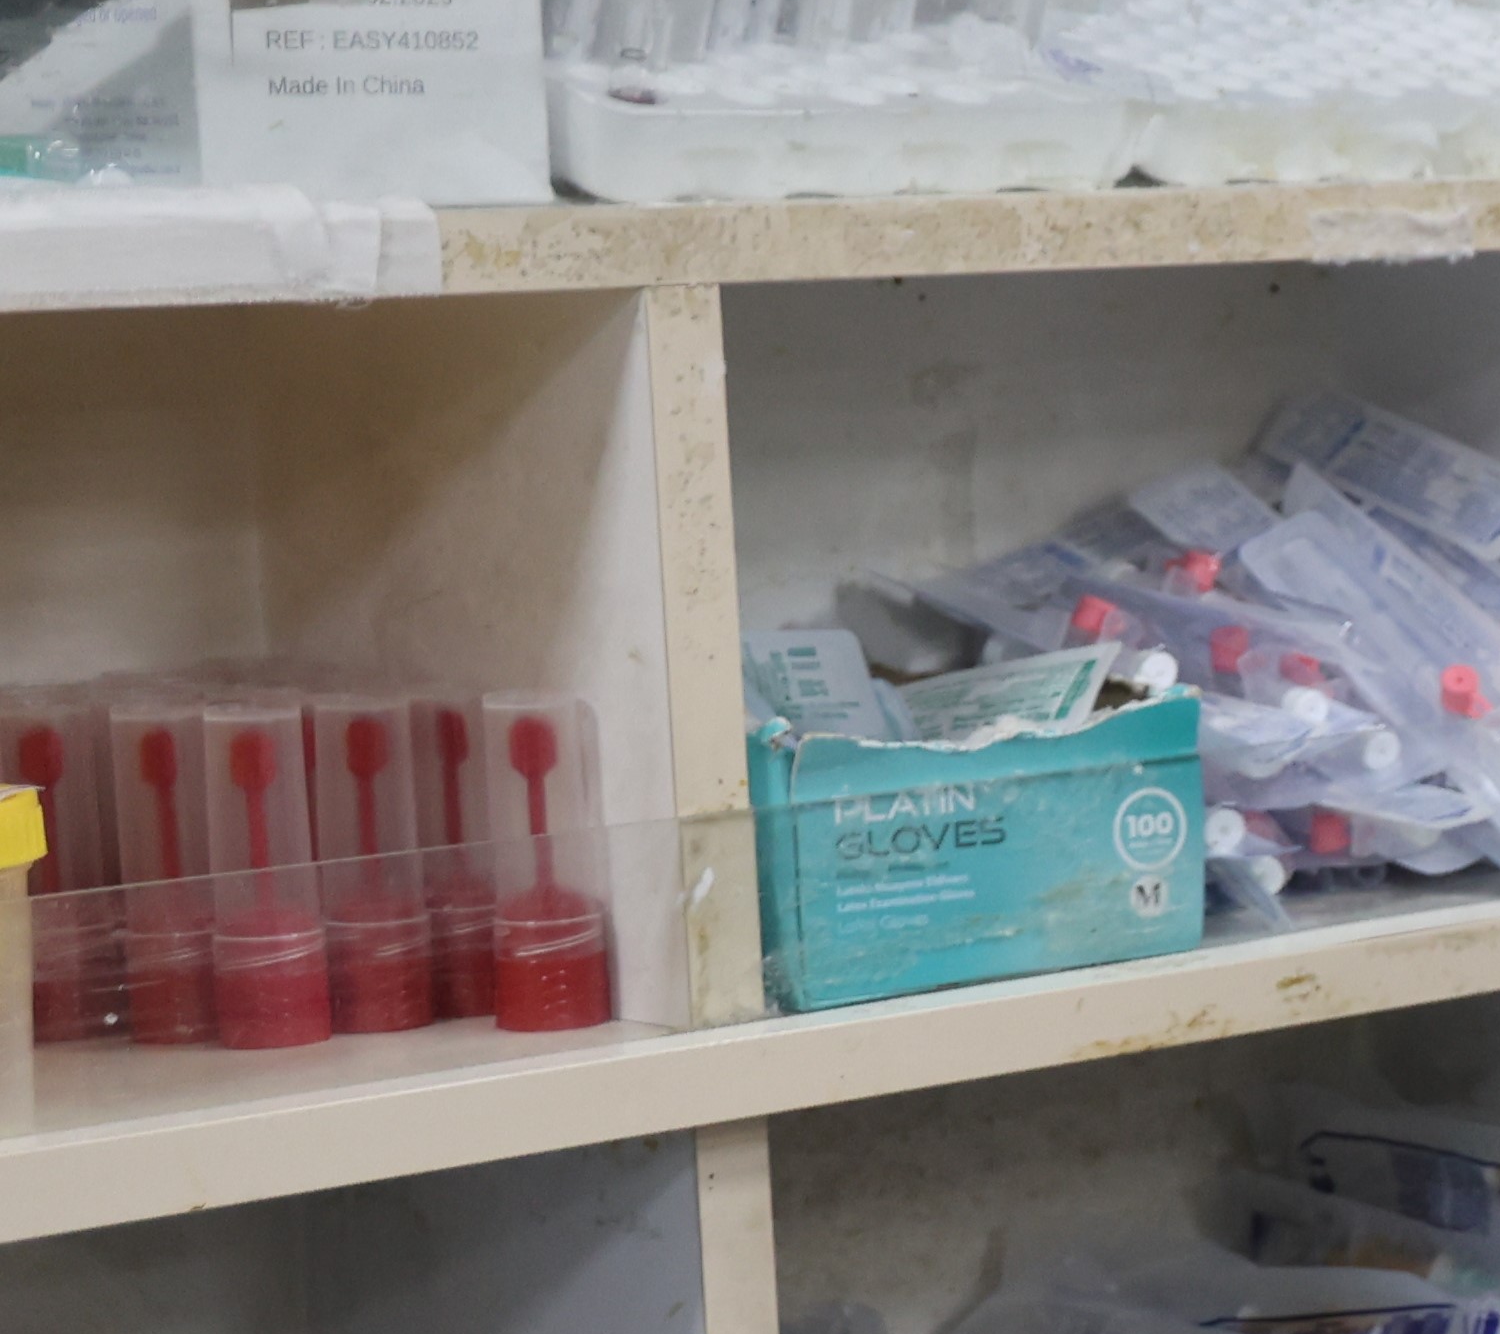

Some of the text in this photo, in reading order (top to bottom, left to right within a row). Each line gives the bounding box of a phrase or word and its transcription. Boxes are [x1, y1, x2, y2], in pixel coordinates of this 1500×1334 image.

[266, 30, 313, 51] REF
[332, 30, 480, 51] EASY410852
[268, 74, 426, 96] Made In China
[832, 782, 977, 825] PLATIN
[1126, 809, 1174, 839] 100
[835, 816, 1008, 861] GLOVES
[1136, 881, 1162, 905] M
